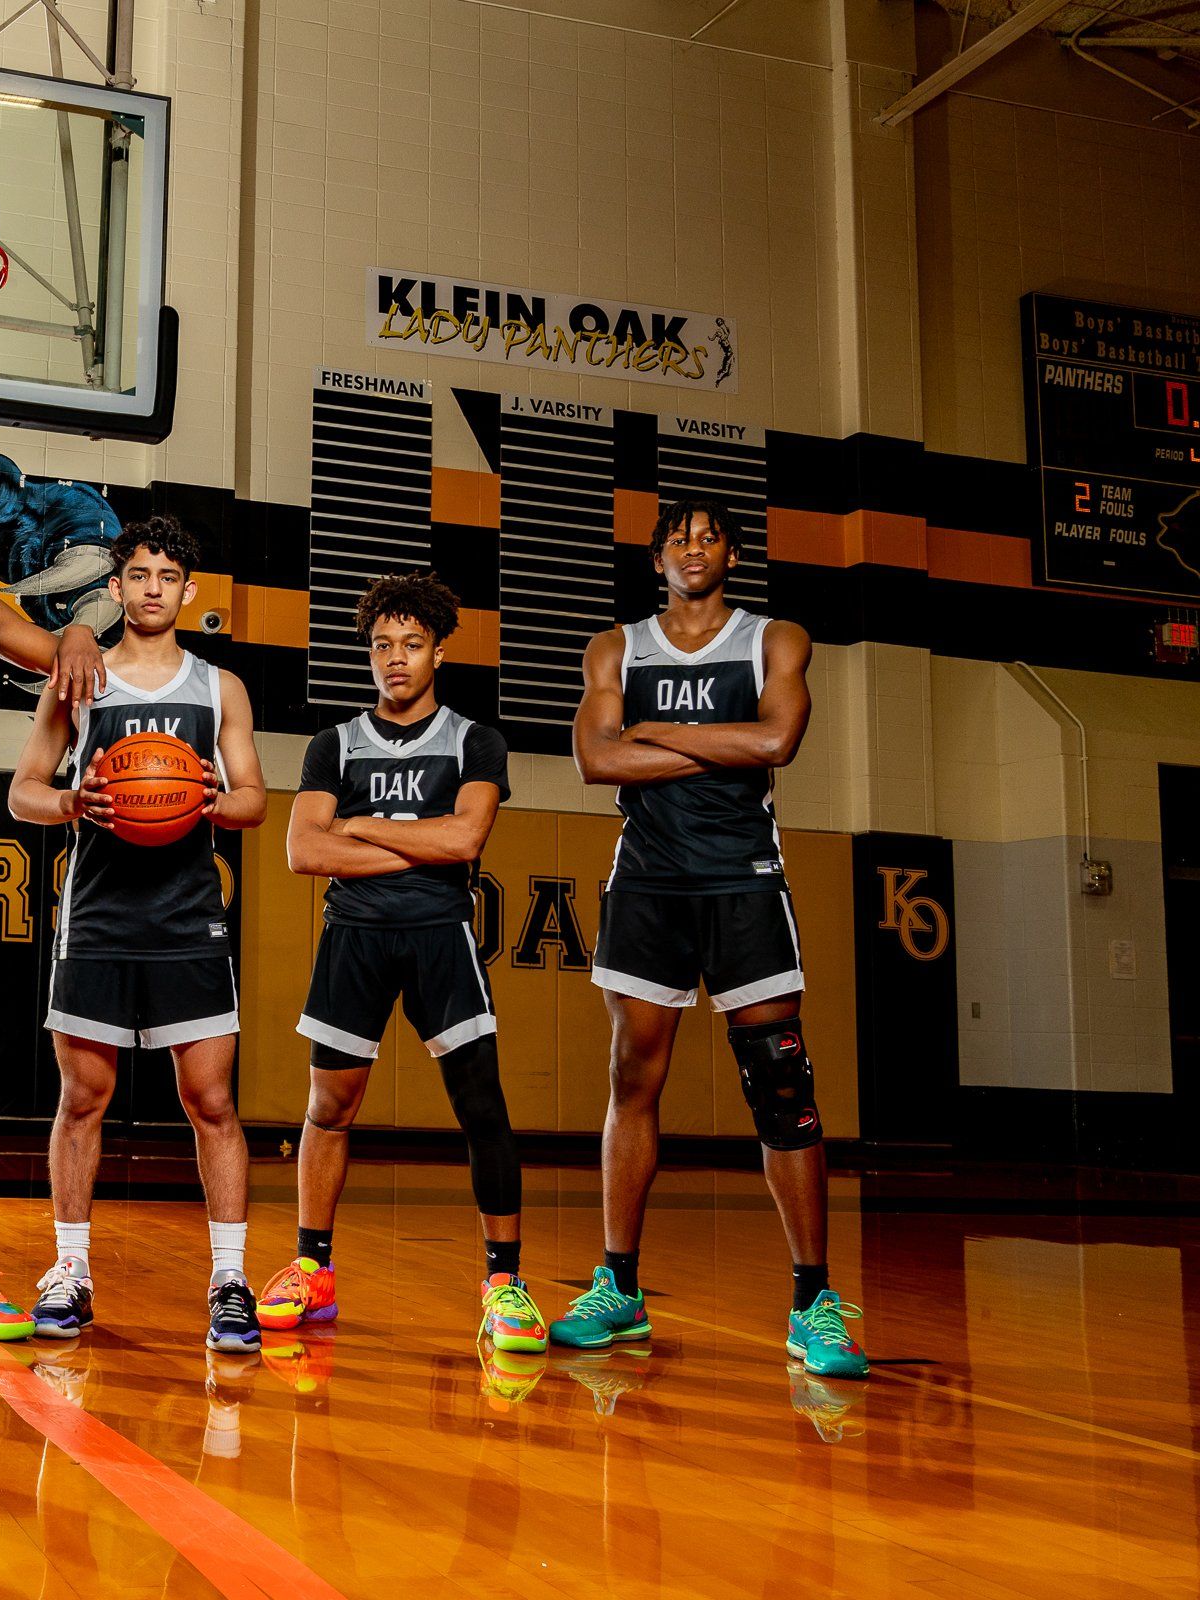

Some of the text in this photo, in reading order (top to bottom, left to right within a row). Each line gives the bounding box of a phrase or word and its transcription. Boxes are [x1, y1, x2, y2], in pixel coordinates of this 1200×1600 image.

[378, 275, 690, 355] KLEIN OAK
[1073, 309, 1121, 334] Boys'
[377, 303, 709, 380] LADY PANTHERS
[1040, 332, 1187, 370] Boys' Basketball
[321, 371, 425, 399] FRESHMAN
[1044, 363, 1125, 395] PANTHERS
[511, 396, 603, 423] J. VARSITY
[676, 417, 746, 441] VARSITY
[1154, 447, 1185, 461] PERIOD
[1073, 481, 1091, 513] 2
[1101, 484, 1133, 502] TEAM
[1100, 500, 1135, 518] FOULS
[1054, 521, 1147, 546] PLAYER FOULS
[657, 677, 715, 711] OAK
[111, 749, 189, 773] Wilson
[114, 790, 188, 805] EVOLUTION
[370, 769, 425, 803] OAK
[877, 866, 950, 962] KO
